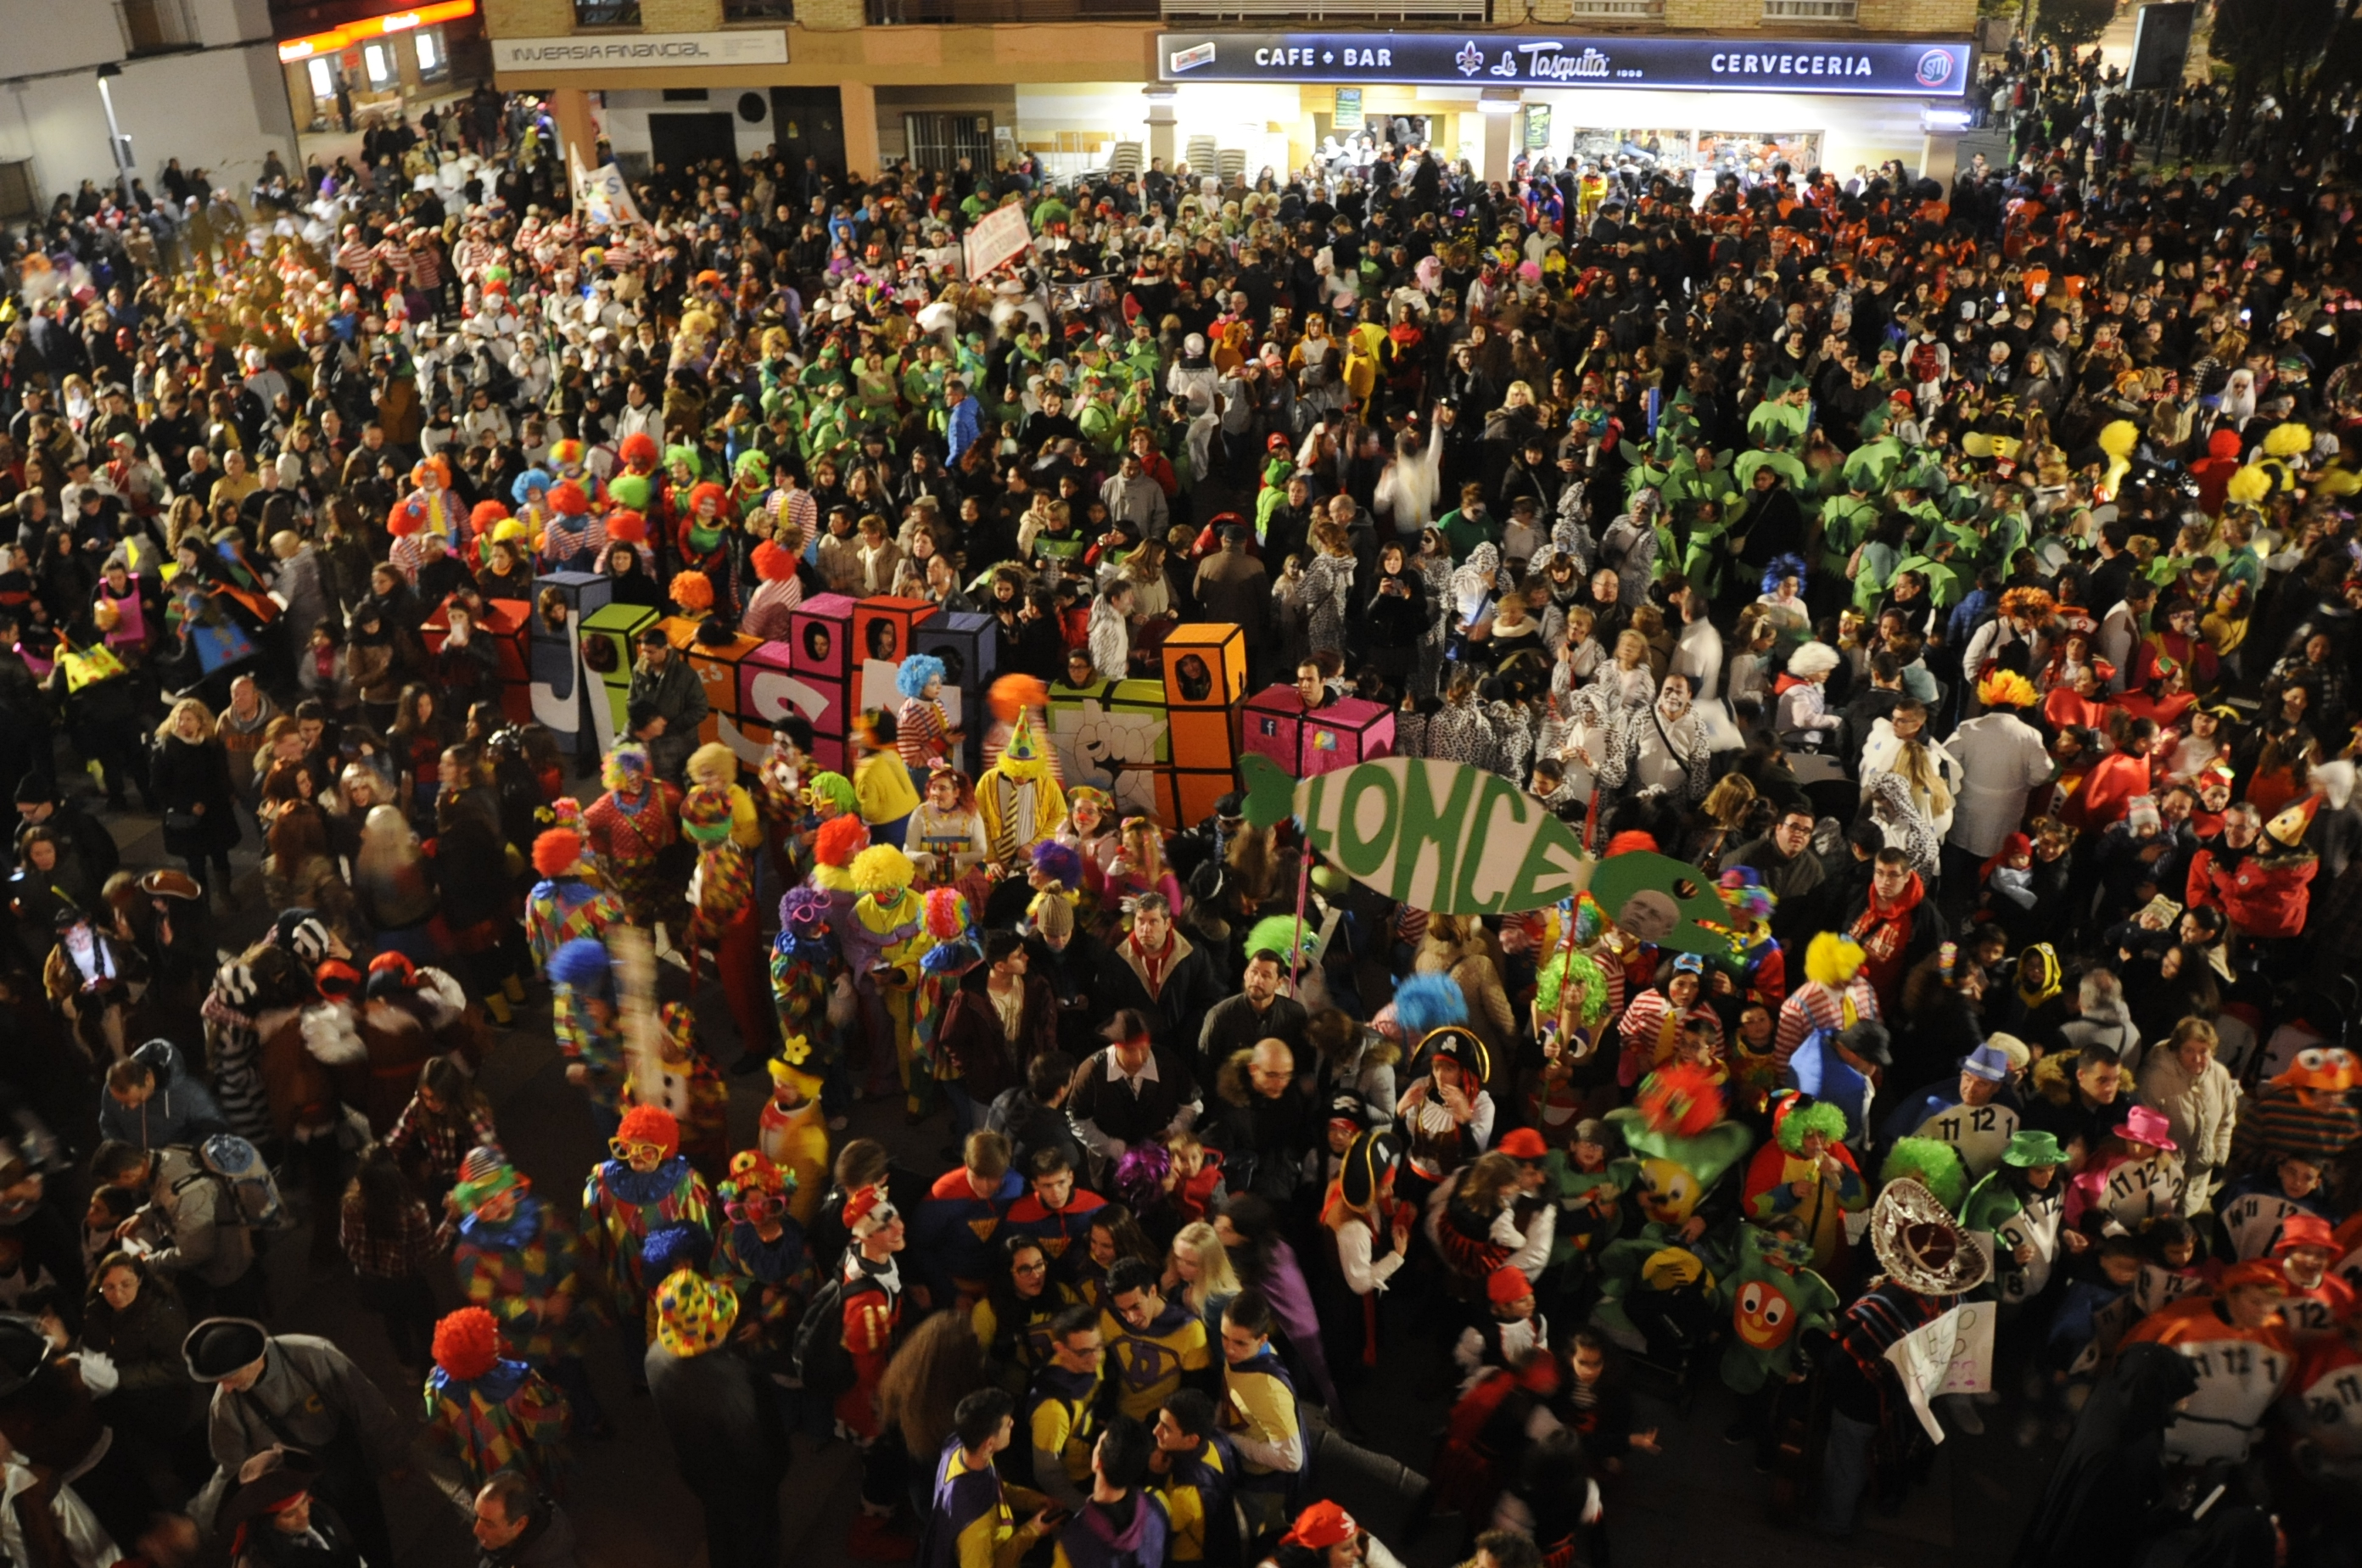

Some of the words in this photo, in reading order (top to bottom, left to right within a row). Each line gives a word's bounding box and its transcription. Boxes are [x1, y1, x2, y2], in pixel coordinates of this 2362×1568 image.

[512, 45, 602, 61] INVERSIA
[1255, 48, 1314, 66] CAFE
[1343, 48, 1392, 67] BAR
[1711, 54, 1872, 76] CERVECERIA
[1306, 758, 1584, 915] LOMCE
[1939, 1118, 1961, 1140] 11
[1970, 1106, 1995, 1132] 12
[2294, 1302, 2328, 1330] 12
